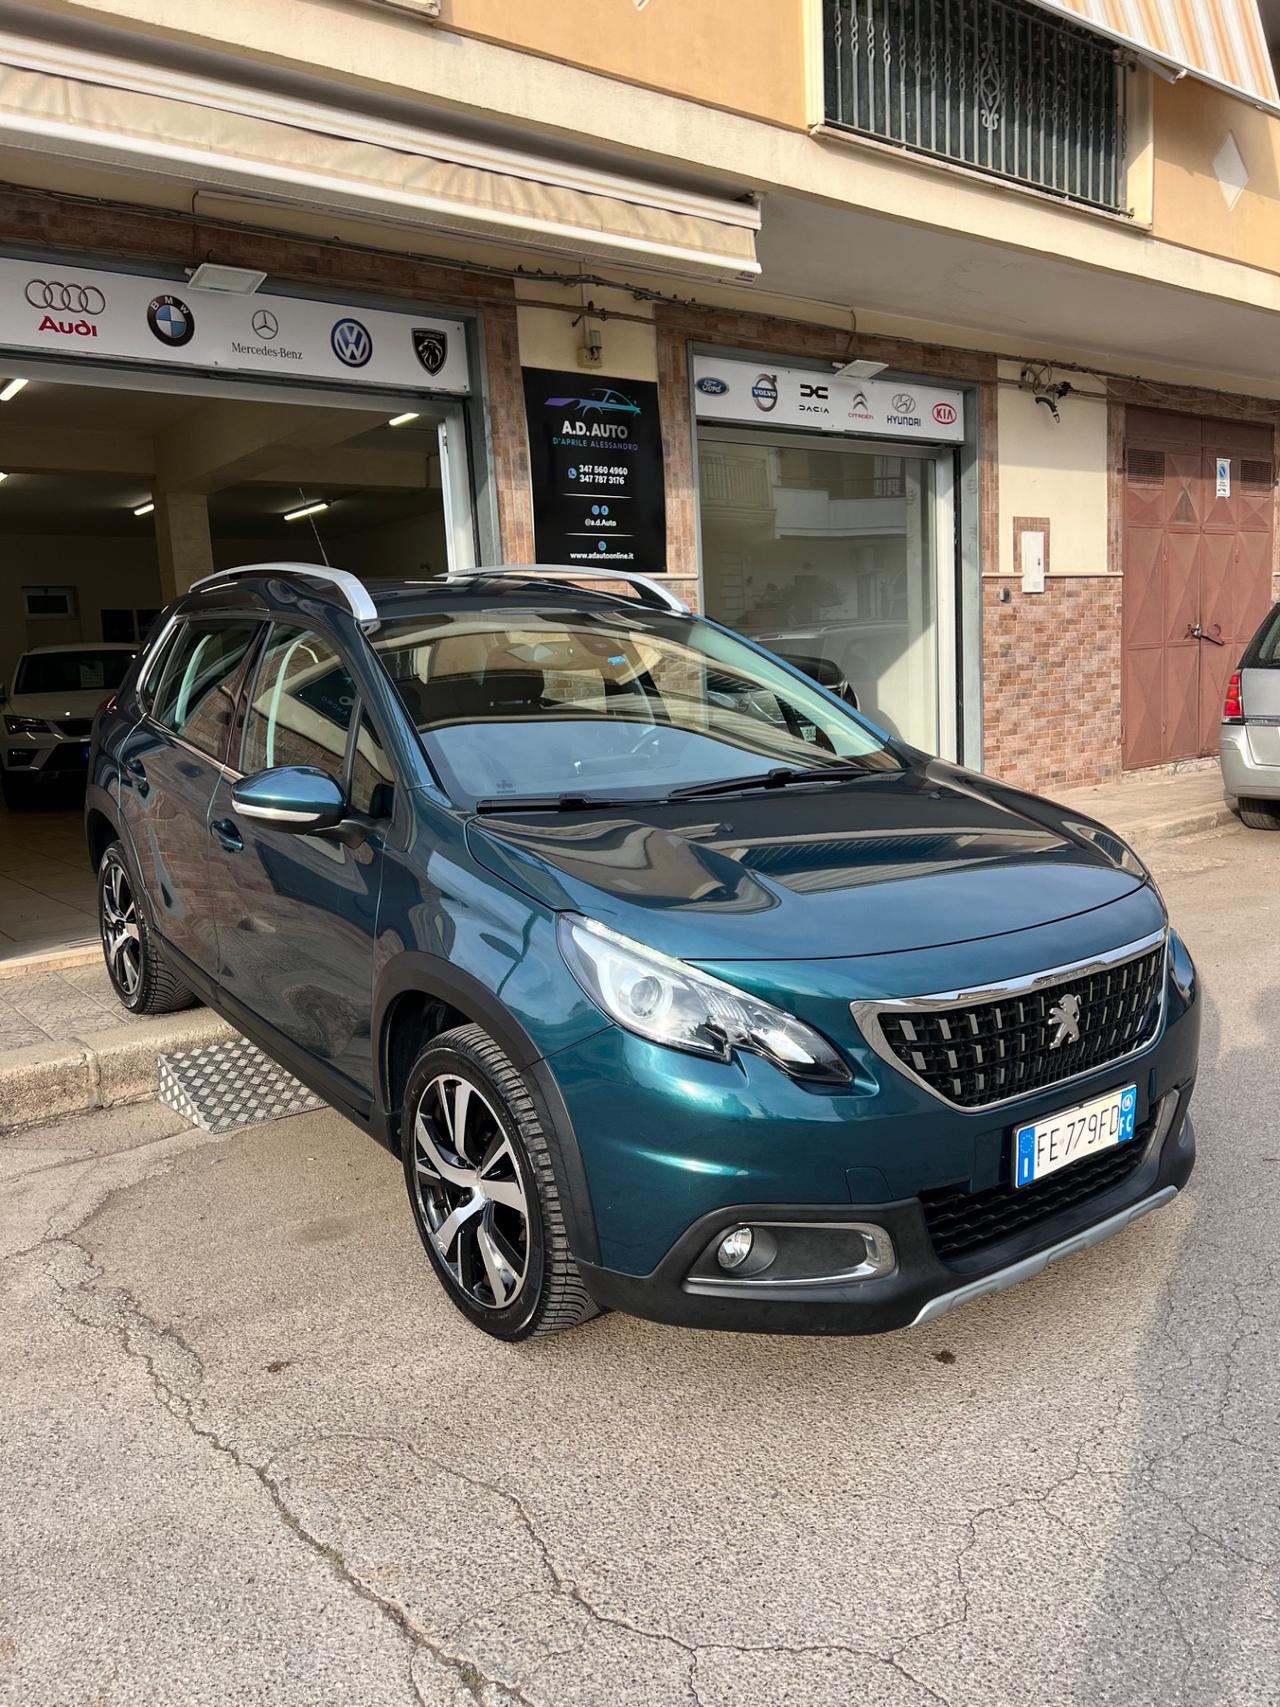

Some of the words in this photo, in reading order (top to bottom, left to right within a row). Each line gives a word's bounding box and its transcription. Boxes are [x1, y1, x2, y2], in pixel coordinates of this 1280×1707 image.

[151, 296, 189, 315] BMW
[38, 315, 98, 337] Audi
[231, 342, 303, 360] Mercedes-Benz
[702, 381, 722, 393] Ford
[753, 388, 776, 397] VOLVO
[799, 404, 830, 414] DACIA
[936, 407, 954, 420] KIA
[886, 415, 921, 427] HYUNDAI
[552, 437, 588, 447] D'APRILE
[590, 441, 639, 451] ALESSANDRO
[579, 465, 592, 473] 347
[594, 466, 608, 474] 560
[609, 467, 628, 475] 4960
[580, 475, 593, 483] 347
[595, 476, 608, 484] 787
[609, 476, 625, 485] 3176
[570, 552, 634, 560] www.adautoonline.it
